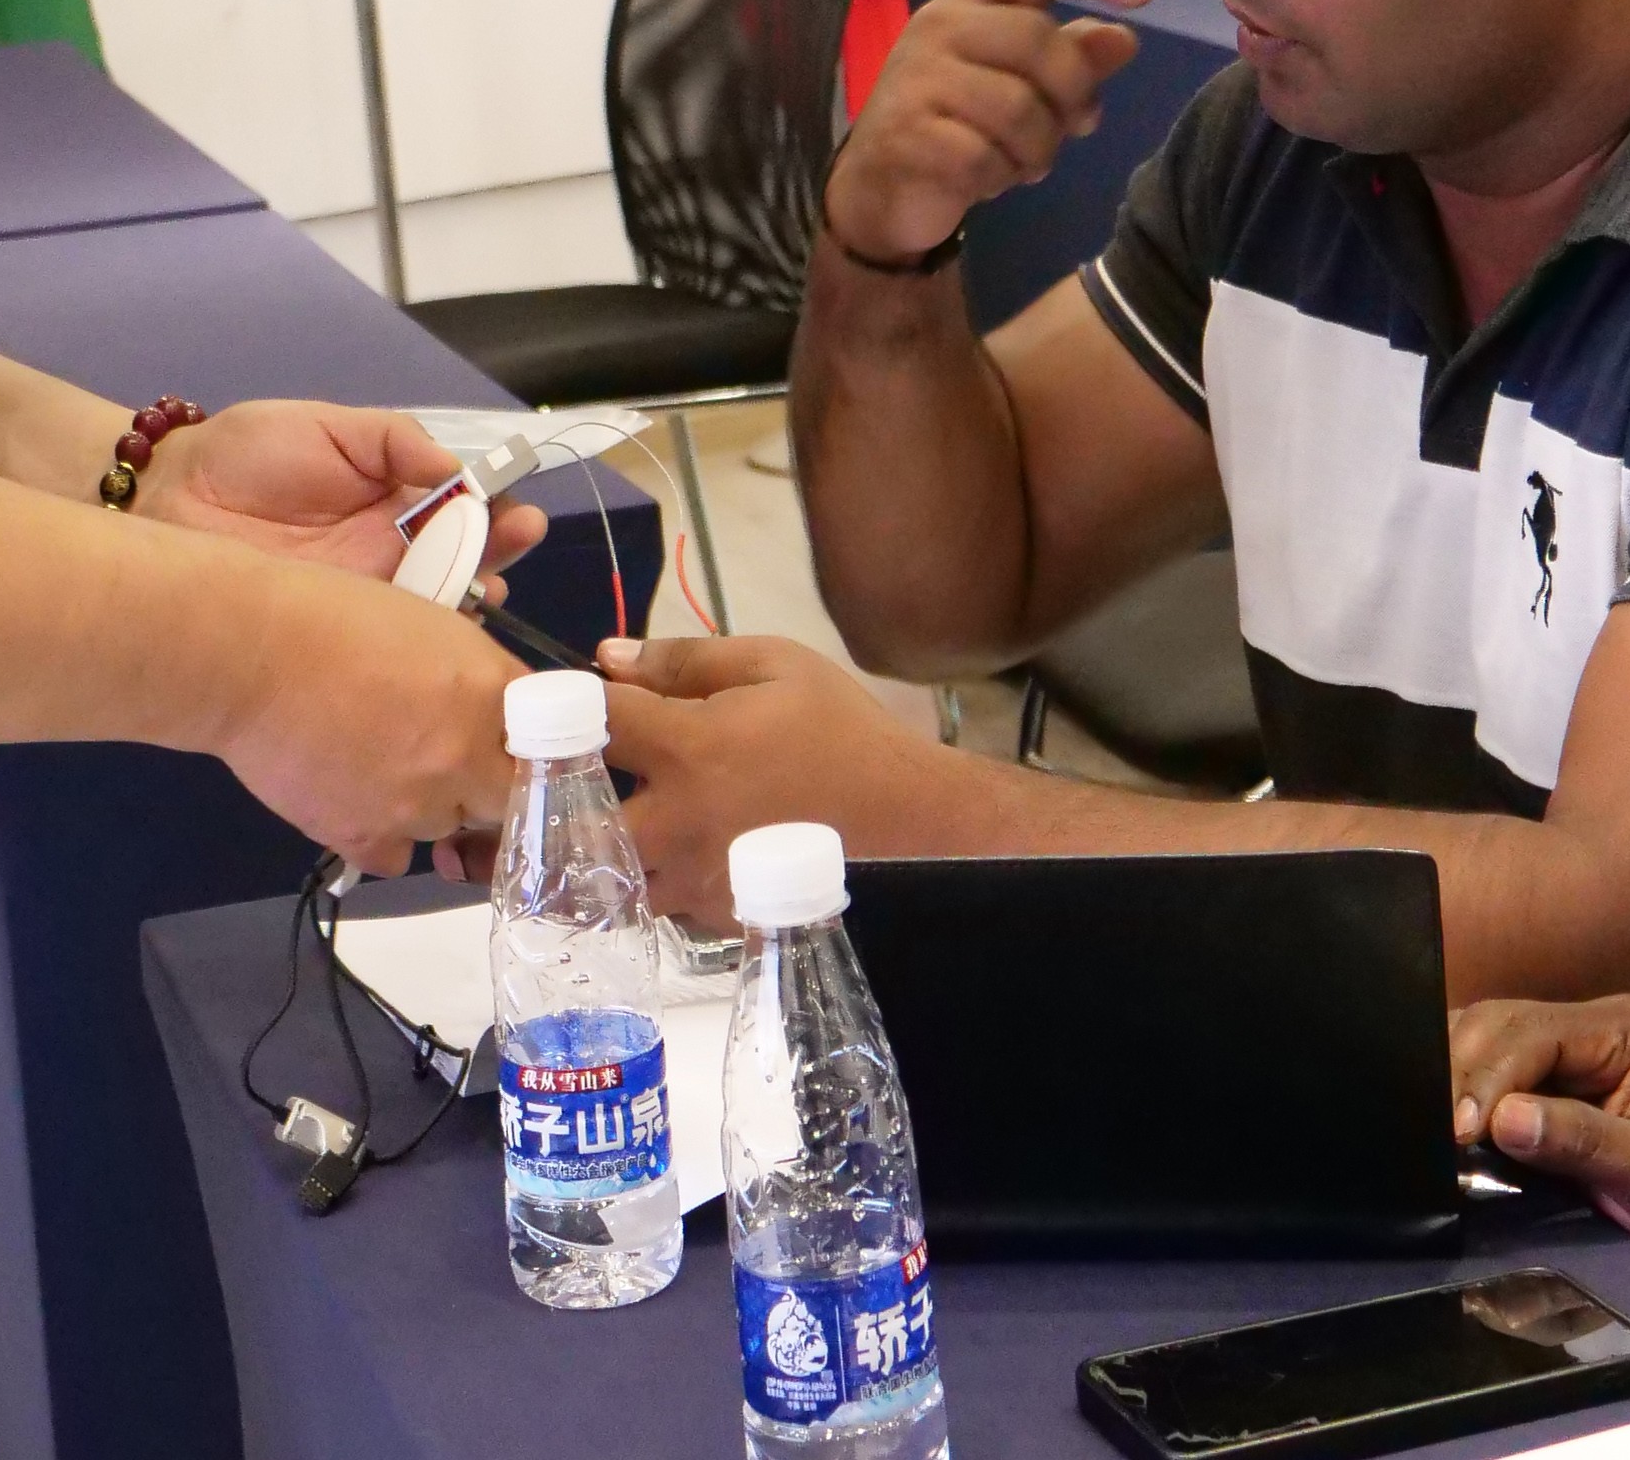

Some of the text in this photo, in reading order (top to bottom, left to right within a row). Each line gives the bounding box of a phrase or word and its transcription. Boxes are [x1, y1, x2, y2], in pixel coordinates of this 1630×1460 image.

[521, 1067, 618, 1092] 我从雪山来
[854, 1283, 933, 1376] 轿子
